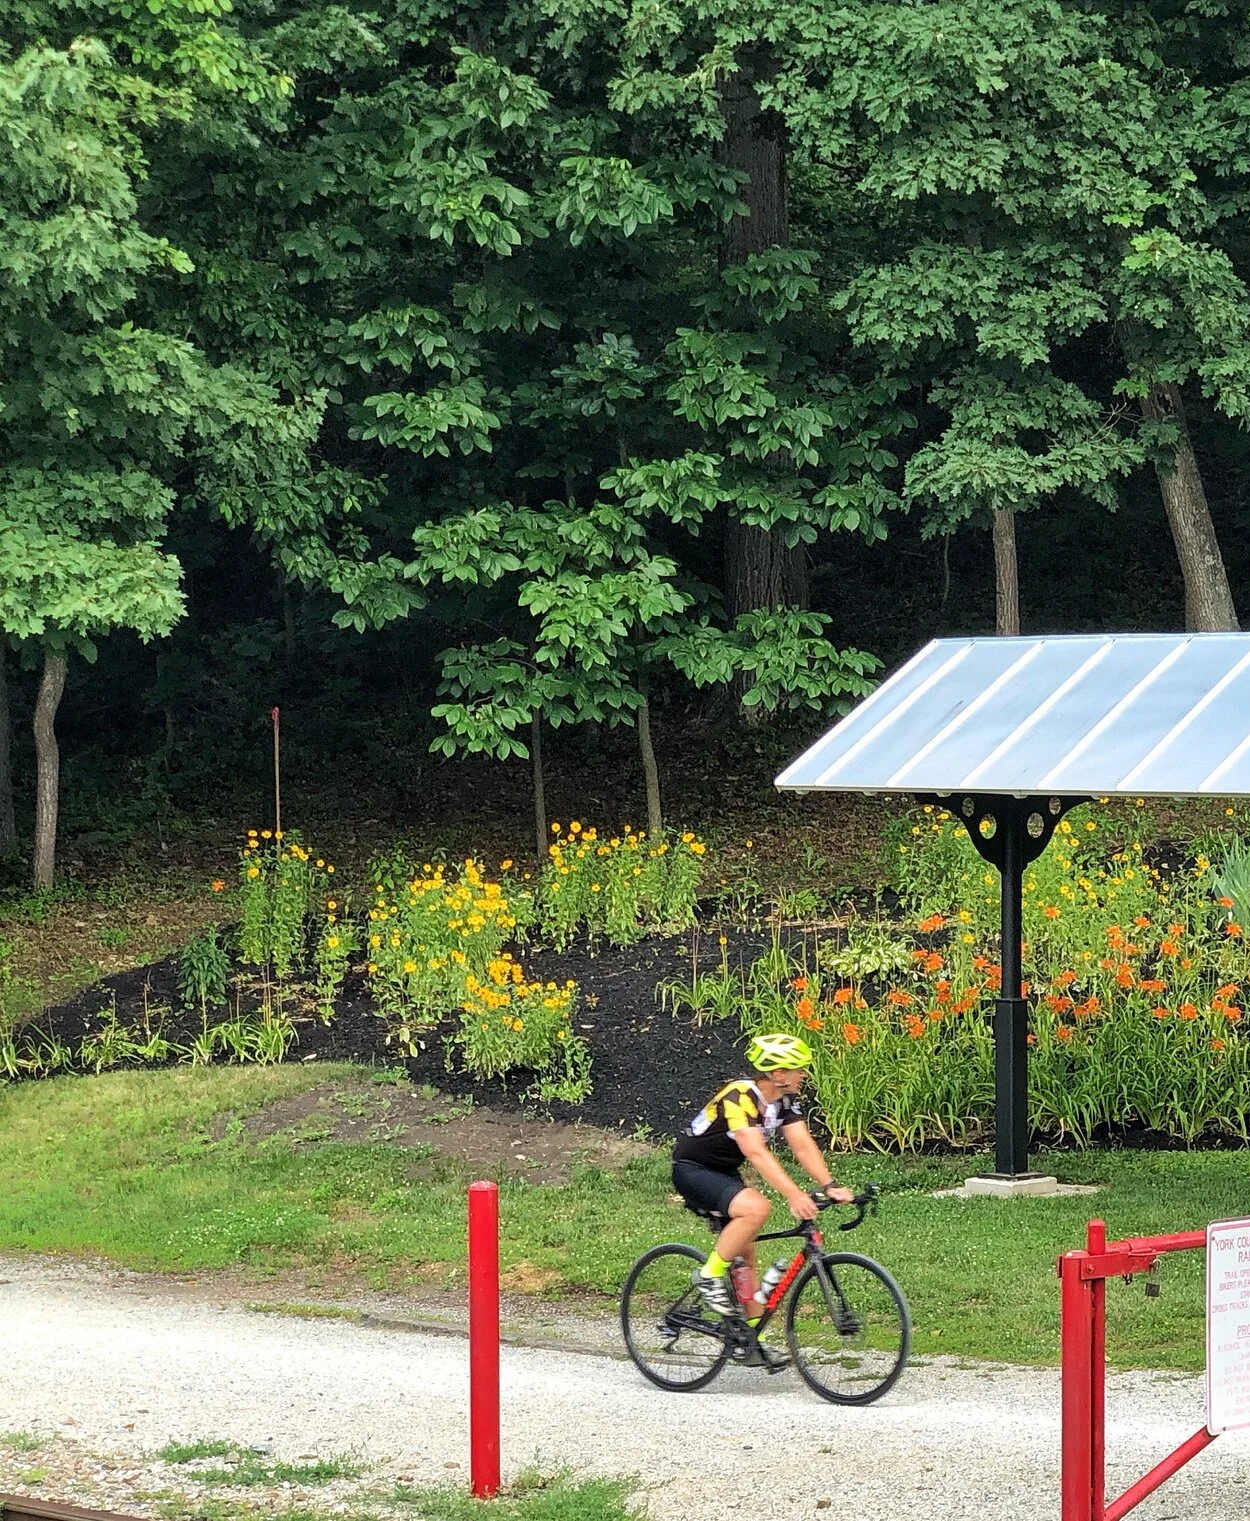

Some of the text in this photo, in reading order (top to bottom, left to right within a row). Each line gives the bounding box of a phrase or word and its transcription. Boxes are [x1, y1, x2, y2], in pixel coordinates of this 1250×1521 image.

[1215, 1238, 1234, 1251] YORK
[1224, 1271, 1238, 1280] TRAIL
[1219, 1281, 1236, 1291] BIKERS
[1240, 1290, 1250, 1299] STAY
[1212, 1303, 1228, 1314] CROSS
[1229, 1300, 1248, 1311] TRACKS
